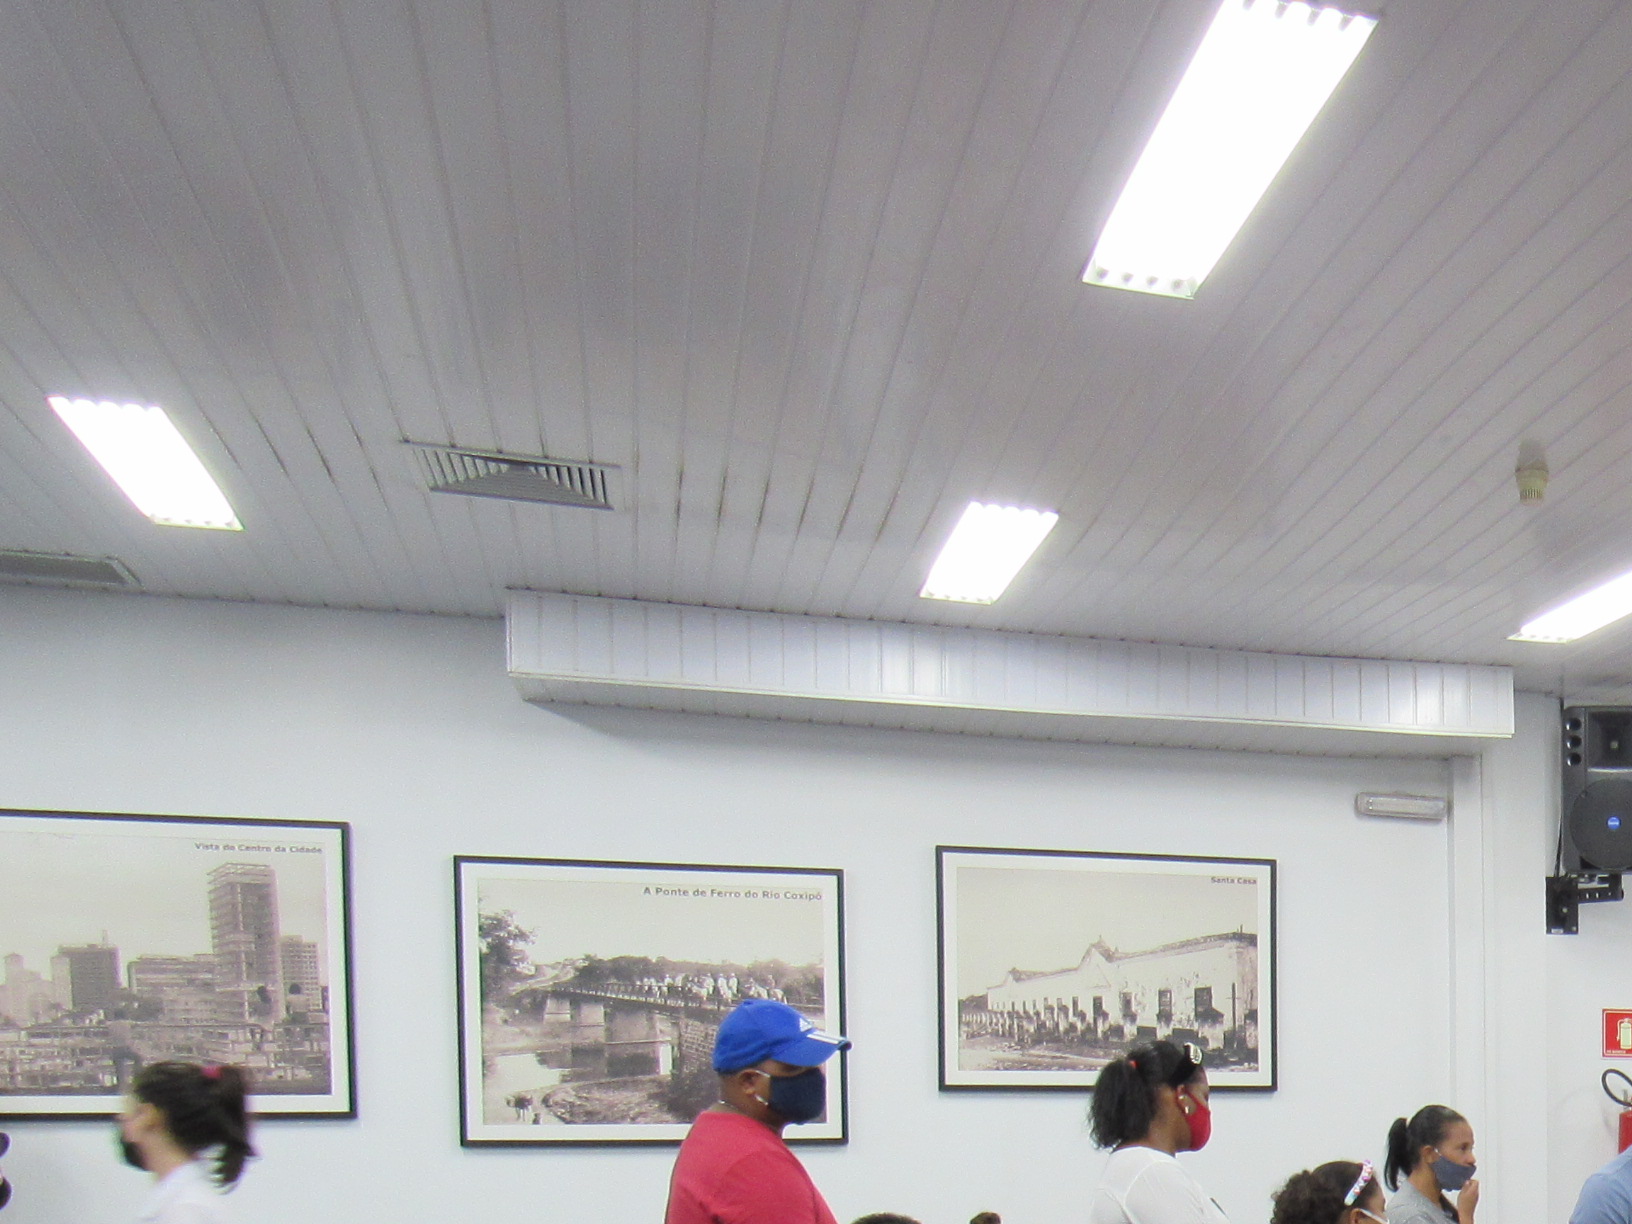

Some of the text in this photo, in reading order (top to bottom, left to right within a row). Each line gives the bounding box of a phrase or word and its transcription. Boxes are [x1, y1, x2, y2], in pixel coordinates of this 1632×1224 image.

[195, 842, 323, 854] Vista do Centro da Cidade
[643, 887, 823, 902] A Ponte de Ferro do Rio Coxipó
